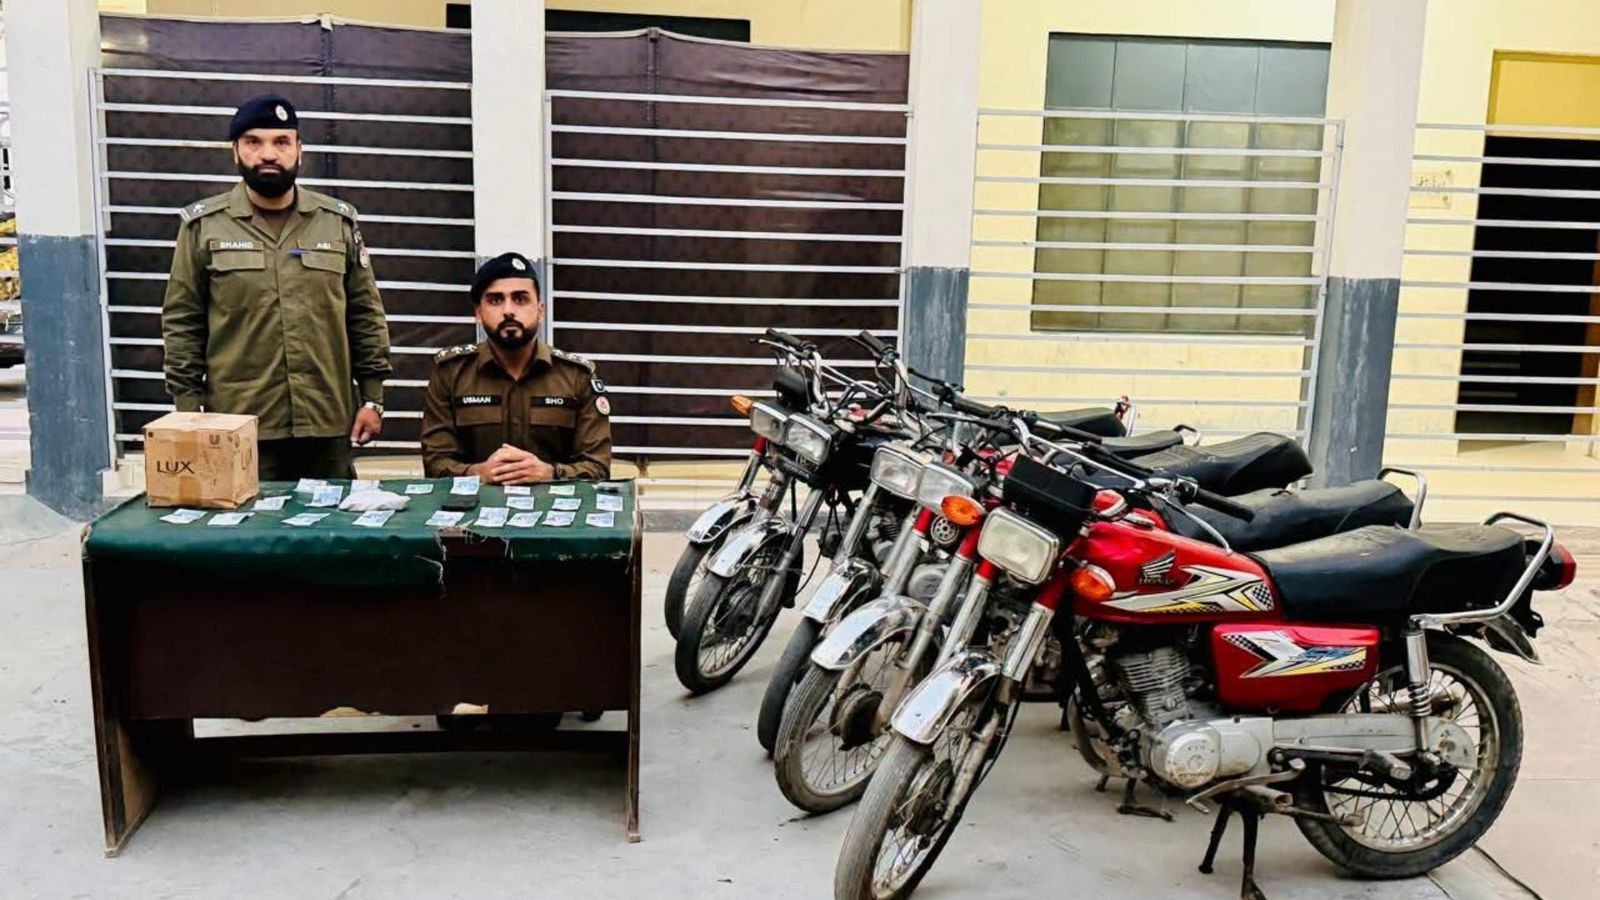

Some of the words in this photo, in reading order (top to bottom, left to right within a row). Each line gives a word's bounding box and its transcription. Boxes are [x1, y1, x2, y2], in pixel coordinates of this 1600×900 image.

[219, 241, 254, 249] SHAHID
[462, 396, 491, 404] USMAN
[545, 397, 564, 405] SHO
[157, 460, 195, 475] LUX
